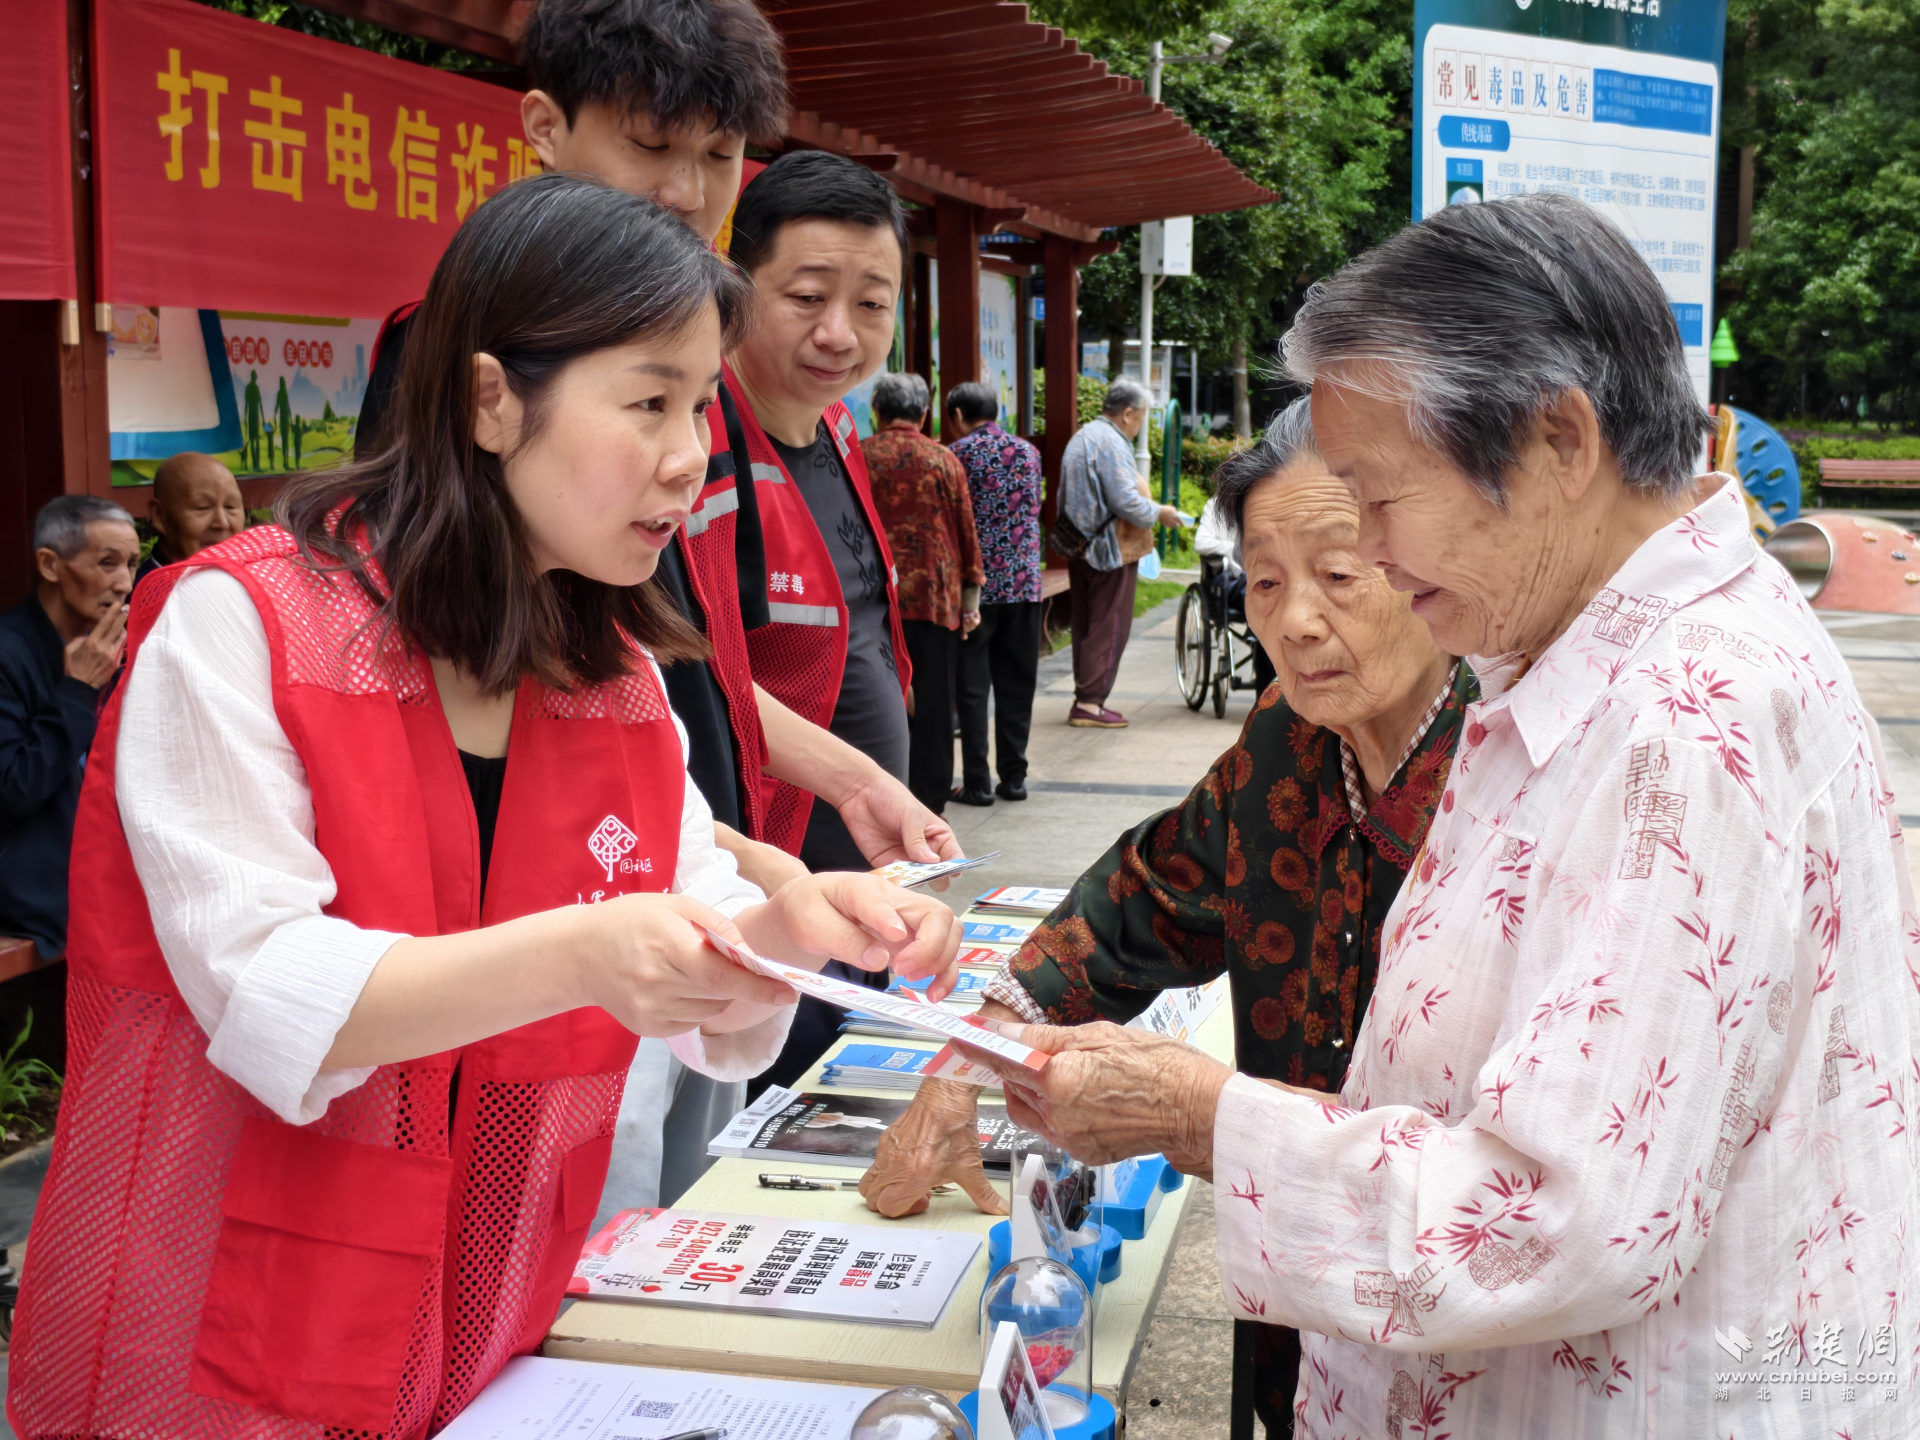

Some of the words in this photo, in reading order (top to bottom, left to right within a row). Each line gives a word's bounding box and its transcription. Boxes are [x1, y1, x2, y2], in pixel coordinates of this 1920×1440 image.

[1437, 60, 1588, 116] 常见毒品及危害
[769, 571, 804, 595] 禁毒
[656, 1218, 700, 1249] 027-110
[662, 1221, 727, 1275] 027-84893110
[715, 1224, 756, 1254] 举报电话
[679, 1261, 745, 1292] 30万
[738, 1229, 816, 1297] 违法犯罪最高奖励
[783, 1236, 850, 1295] 武汉市举报毒品
[839, 1250, 886, 1287] 远离毒品
[873, 1253, 918, 1291] 珍爱生命
